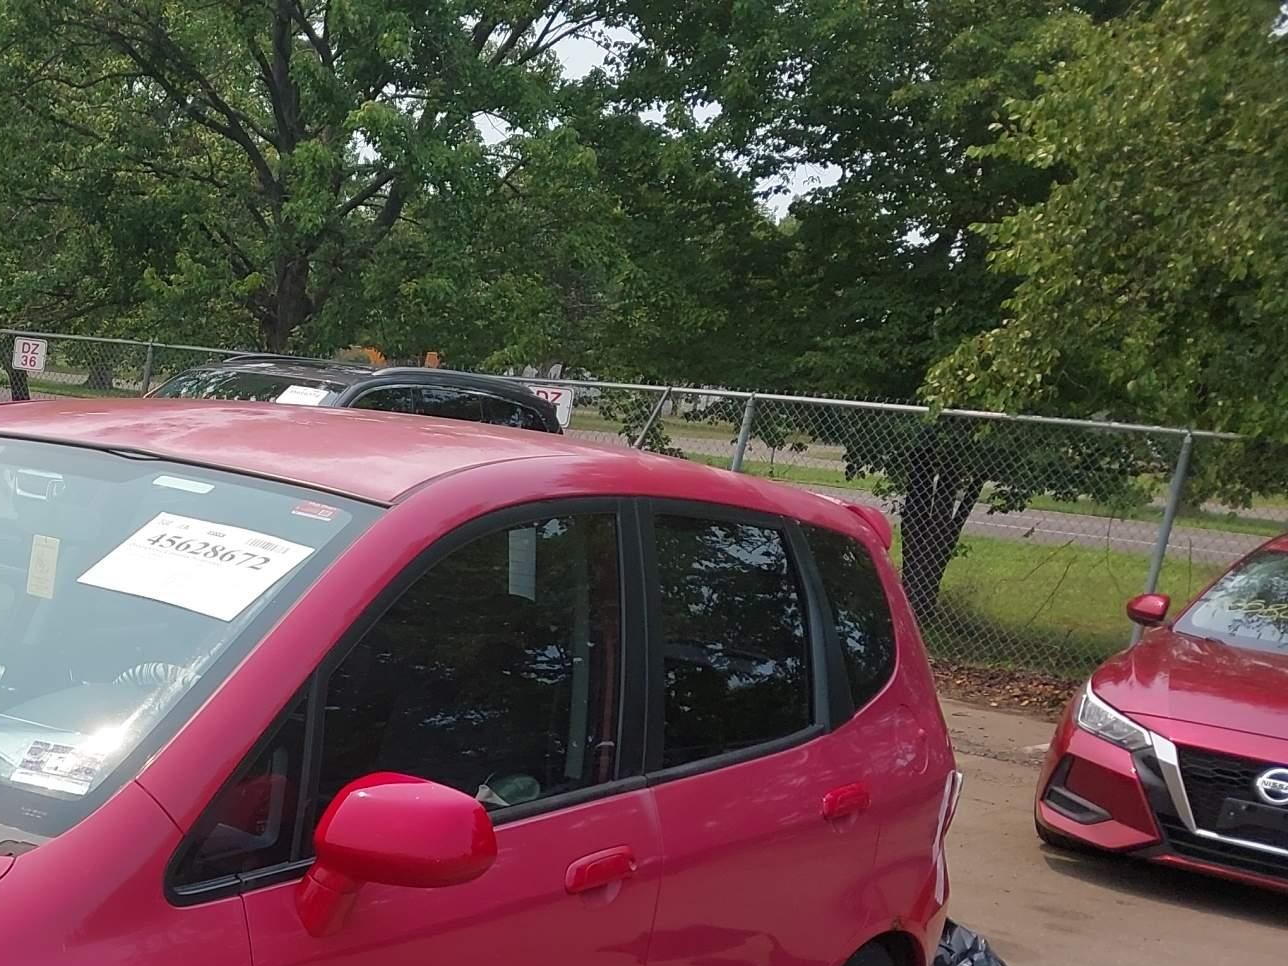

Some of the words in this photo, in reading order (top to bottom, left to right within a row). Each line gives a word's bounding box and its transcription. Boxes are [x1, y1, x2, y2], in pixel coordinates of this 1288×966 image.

[22, 342, 40, 355] DZ
[21, 355, 37, 367] 36
[146, 532, 271, 570] 45628672
